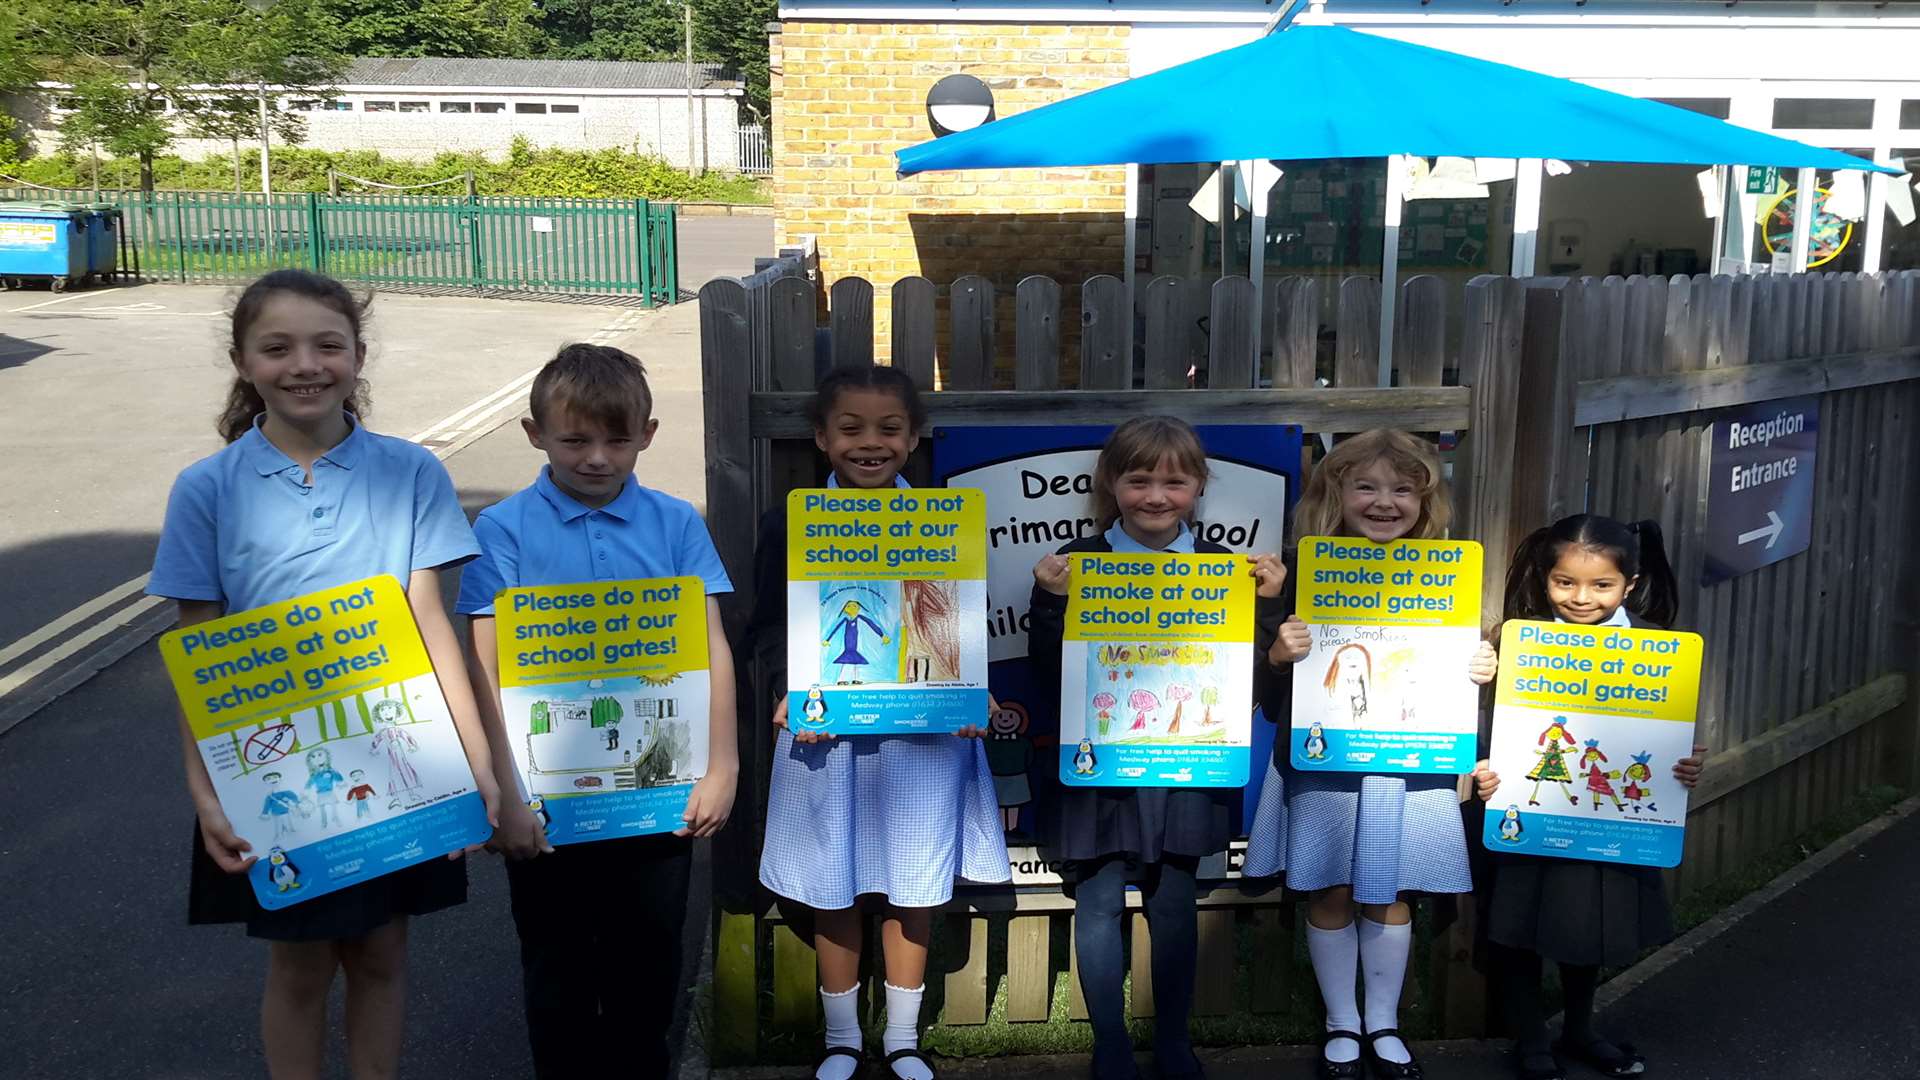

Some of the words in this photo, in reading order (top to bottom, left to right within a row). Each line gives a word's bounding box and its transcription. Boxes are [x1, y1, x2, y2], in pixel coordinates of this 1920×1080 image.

[1750, 168, 1762, 177] Fire
[1750, 180, 1760, 189] exit
[1730, 410, 1804, 449] Reception
[1021, 470, 1093, 498] Dea
[1731, 456, 1797, 492] Entrance
[805, 494, 881, 512] Please
[889, 494, 918, 512] do
[926, 494, 964, 512] not
[805, 519, 881, 537] smoke
[889, 521, 913, 537] at
[920, 523, 958, 538] our
[805, 545, 878, 563] school
[886, 545, 957, 567] gates!
[1315, 542, 1386, 561] Please
[1393, 544, 1420, 562] do
[1428, 546, 1463, 563] not
[1081, 558, 1155, 576] Please
[1162, 558, 1190, 576] do
[1198, 560, 1235, 576] not
[1314, 567, 1384, 585] smoke
[1392, 570, 1414, 586] at
[1420, 572, 1456, 587] our
[513, 590, 596, 613] Please
[603, 586, 634, 606] do
[642, 584, 681, 603] not
[1081, 582, 1153, 600] smoke
[1161, 584, 1184, 600] at
[1191, 586, 1229, 600] our
[1312, 590, 1380, 608] school
[1387, 594, 1453, 613] gates!
[181, 616, 278, 656] Please
[285, 604, 321, 627] do
[330, 586, 375, 615] not
[515, 615, 597, 640] smoke
[605, 613, 630, 633] at
[637, 613, 677, 631] our
[1080, 606, 1150, 624] school
[1157, 609, 1226, 629] gates!
[1320, 624, 1339, 638] No
[1520, 627, 1596, 649] Please
[1603, 633, 1633, 651] do
[1641, 637, 1680, 654] not
[193, 645, 289, 685] smoke
[296, 631, 325, 655] at
[333, 617, 379, 646] our
[517, 641, 596, 667] school
[604, 636, 677, 664] gates!
[1517, 653, 1593, 672] smoke
[1600, 657, 1625, 674] at
[1632, 662, 1672, 678] our
[205, 670, 296, 714] school
[304, 645, 390, 690] gates!
[1515, 675, 1588, 695] school
[1595, 681, 1668, 702] gates!
